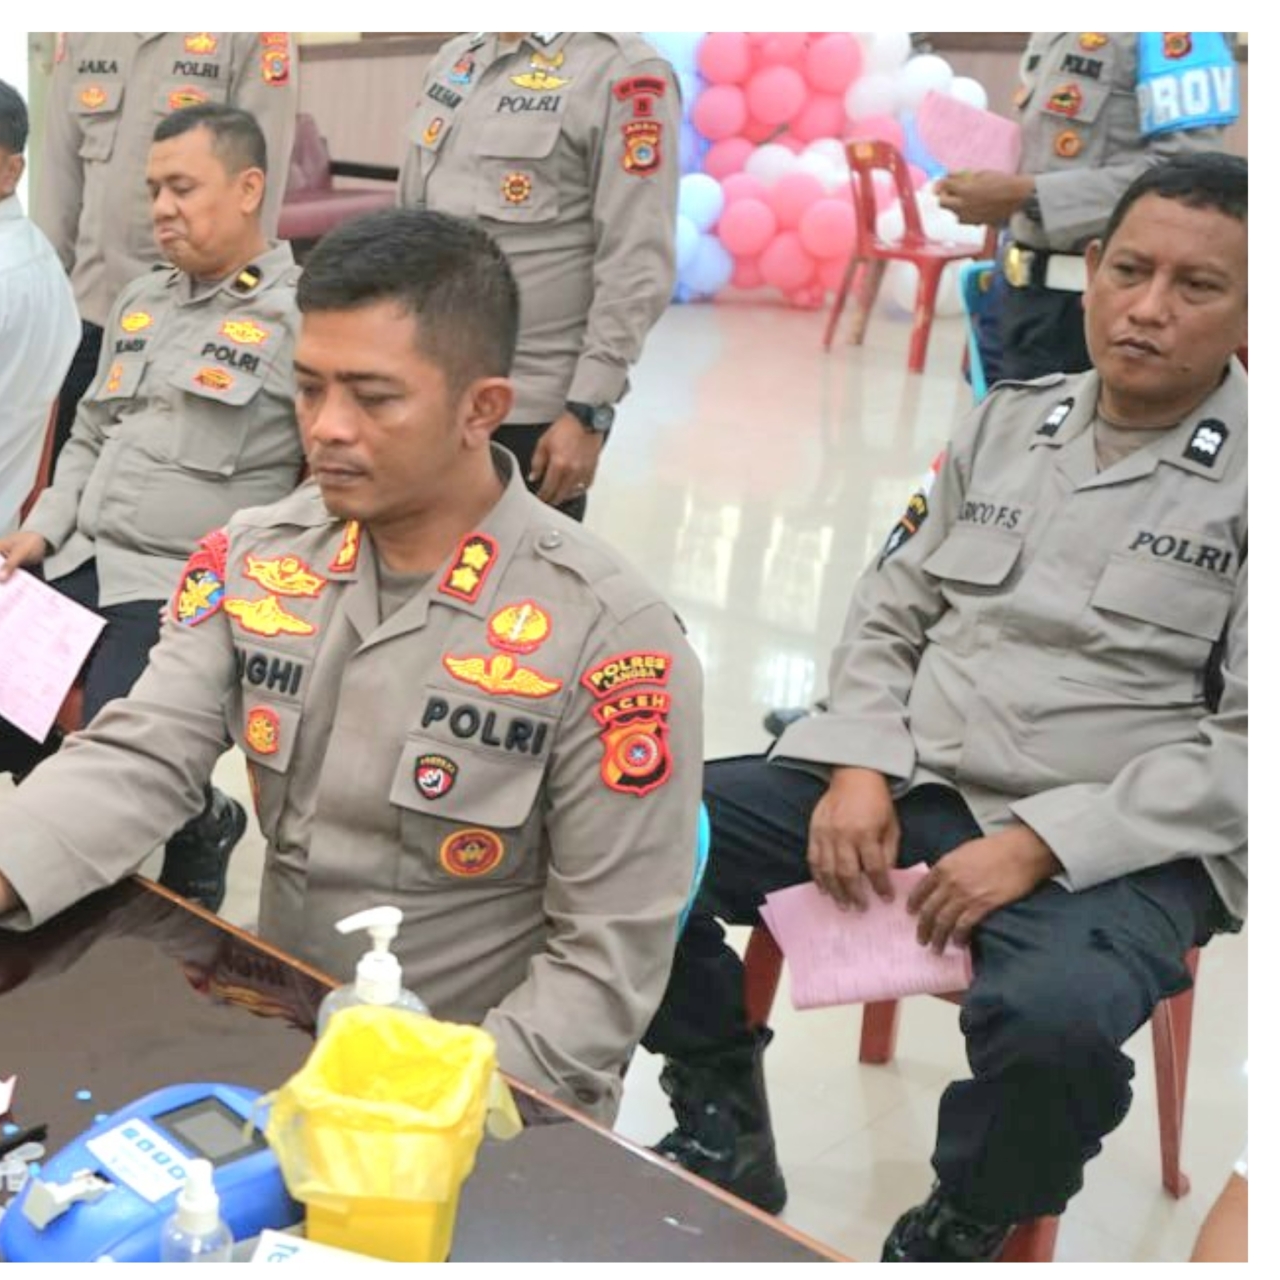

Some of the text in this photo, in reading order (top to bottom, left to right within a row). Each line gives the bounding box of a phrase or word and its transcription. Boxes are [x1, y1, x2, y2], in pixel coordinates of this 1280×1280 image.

[173, 61, 220, 78] POLRI
[497, 96, 562, 113] POLRI
[201, 342, 260, 372] POLRI
[1129, 530, 1233, 575] POLRI
[591, 656, 666, 686] POLRES
[602, 695, 665, 718] ACEH
[421, 697, 548, 756] POLRI
